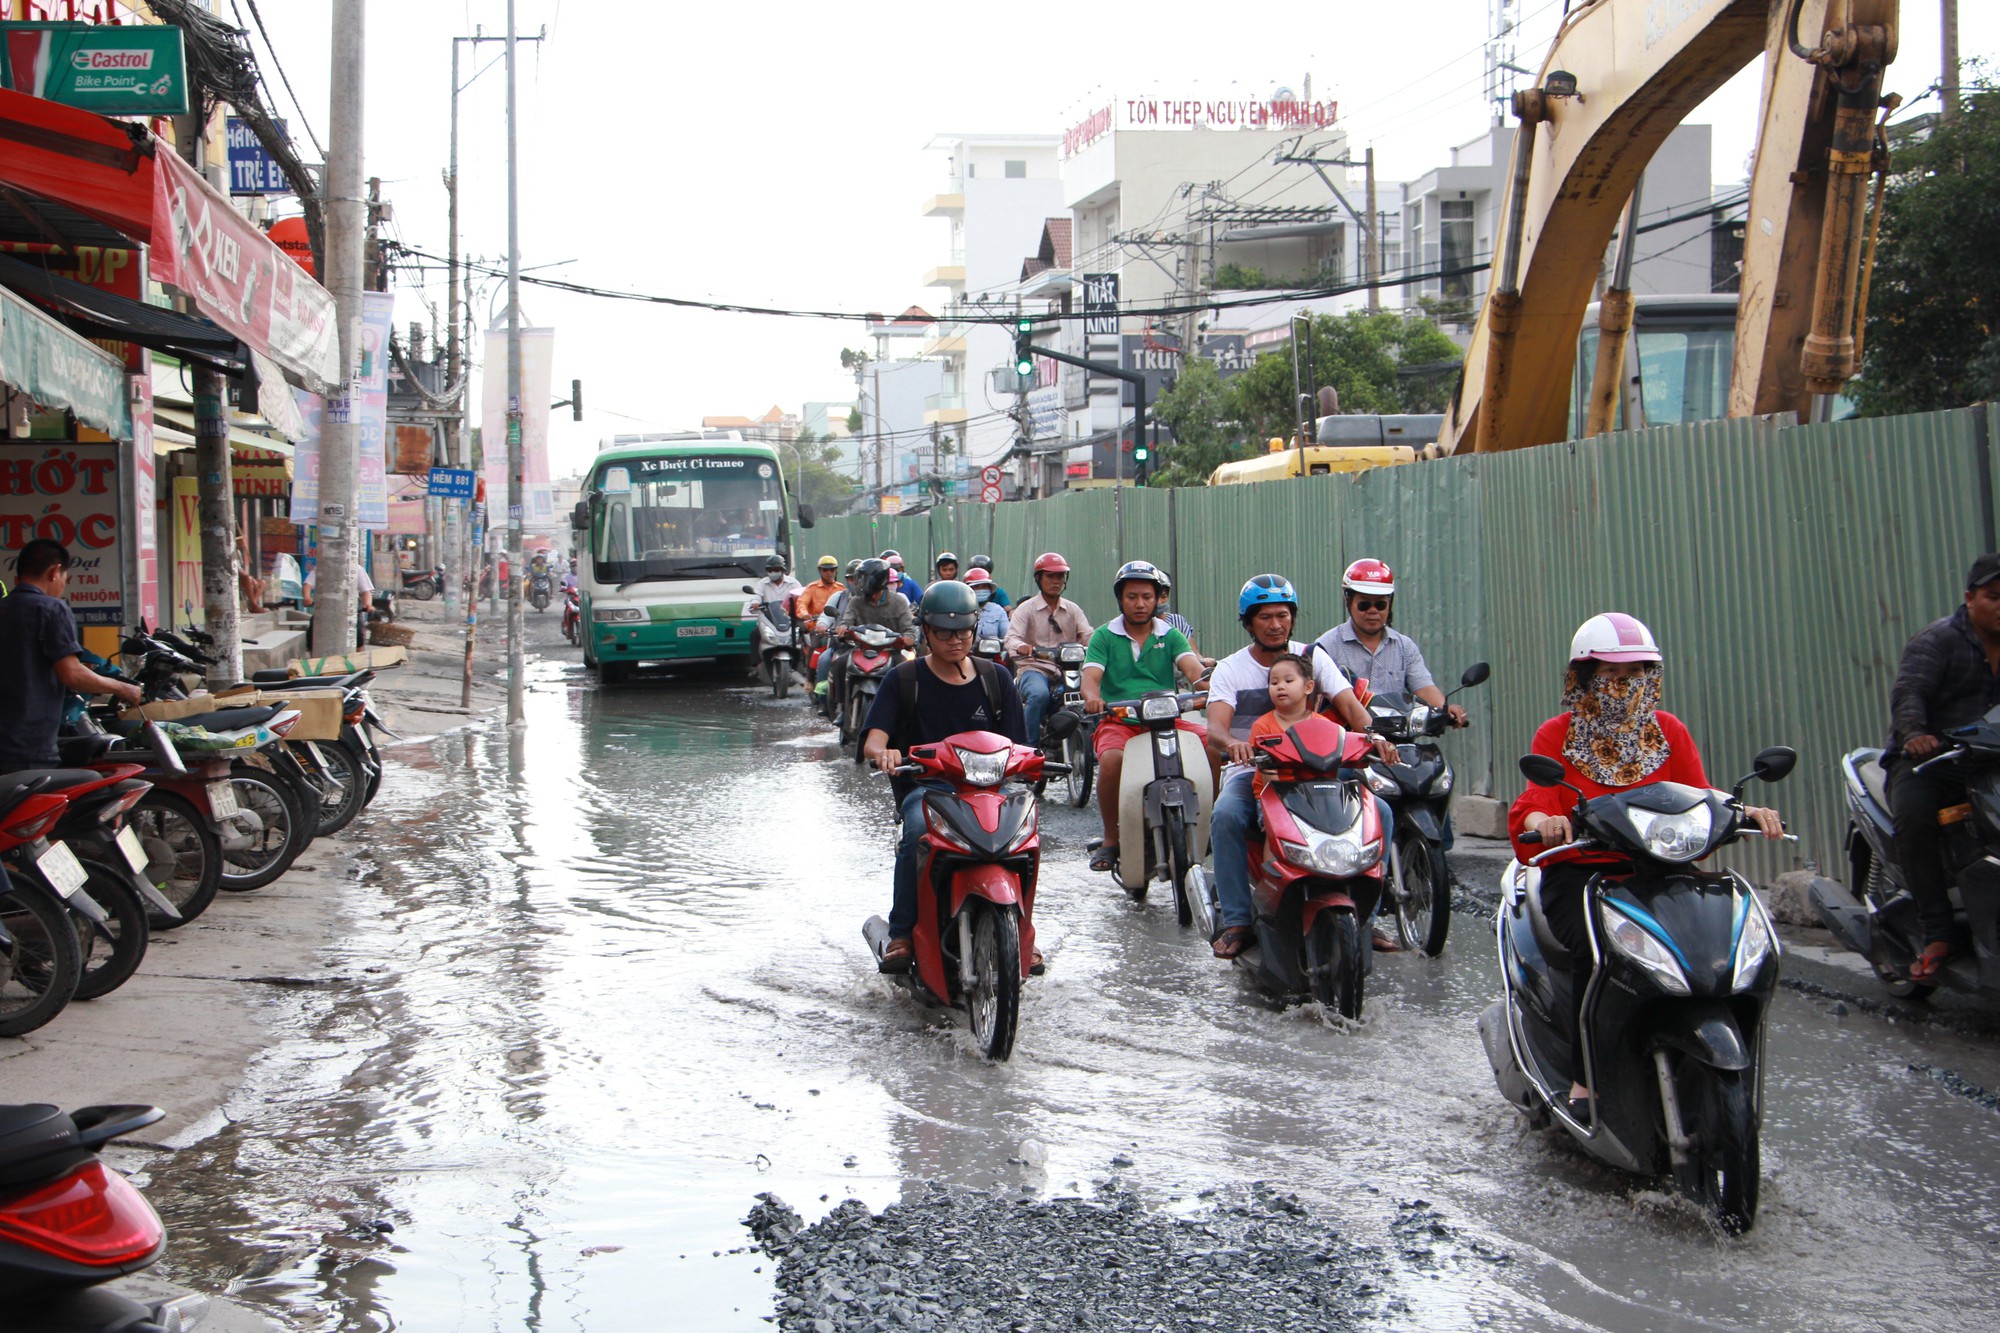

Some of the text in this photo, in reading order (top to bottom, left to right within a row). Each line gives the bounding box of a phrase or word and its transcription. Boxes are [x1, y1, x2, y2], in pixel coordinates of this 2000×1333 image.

[92, 52, 149, 68] Castrol
[75, 76, 135, 87] Bike Point
[1088, 277, 1116, 303] MẮT
[0, 448, 116, 495] HỚT
[233, 473, 283, 495] TÍNH
[0, 503, 116, 549] TÓC
[79, 574, 100, 585] TAI
[70, 589, 120, 603] NHUỘM
